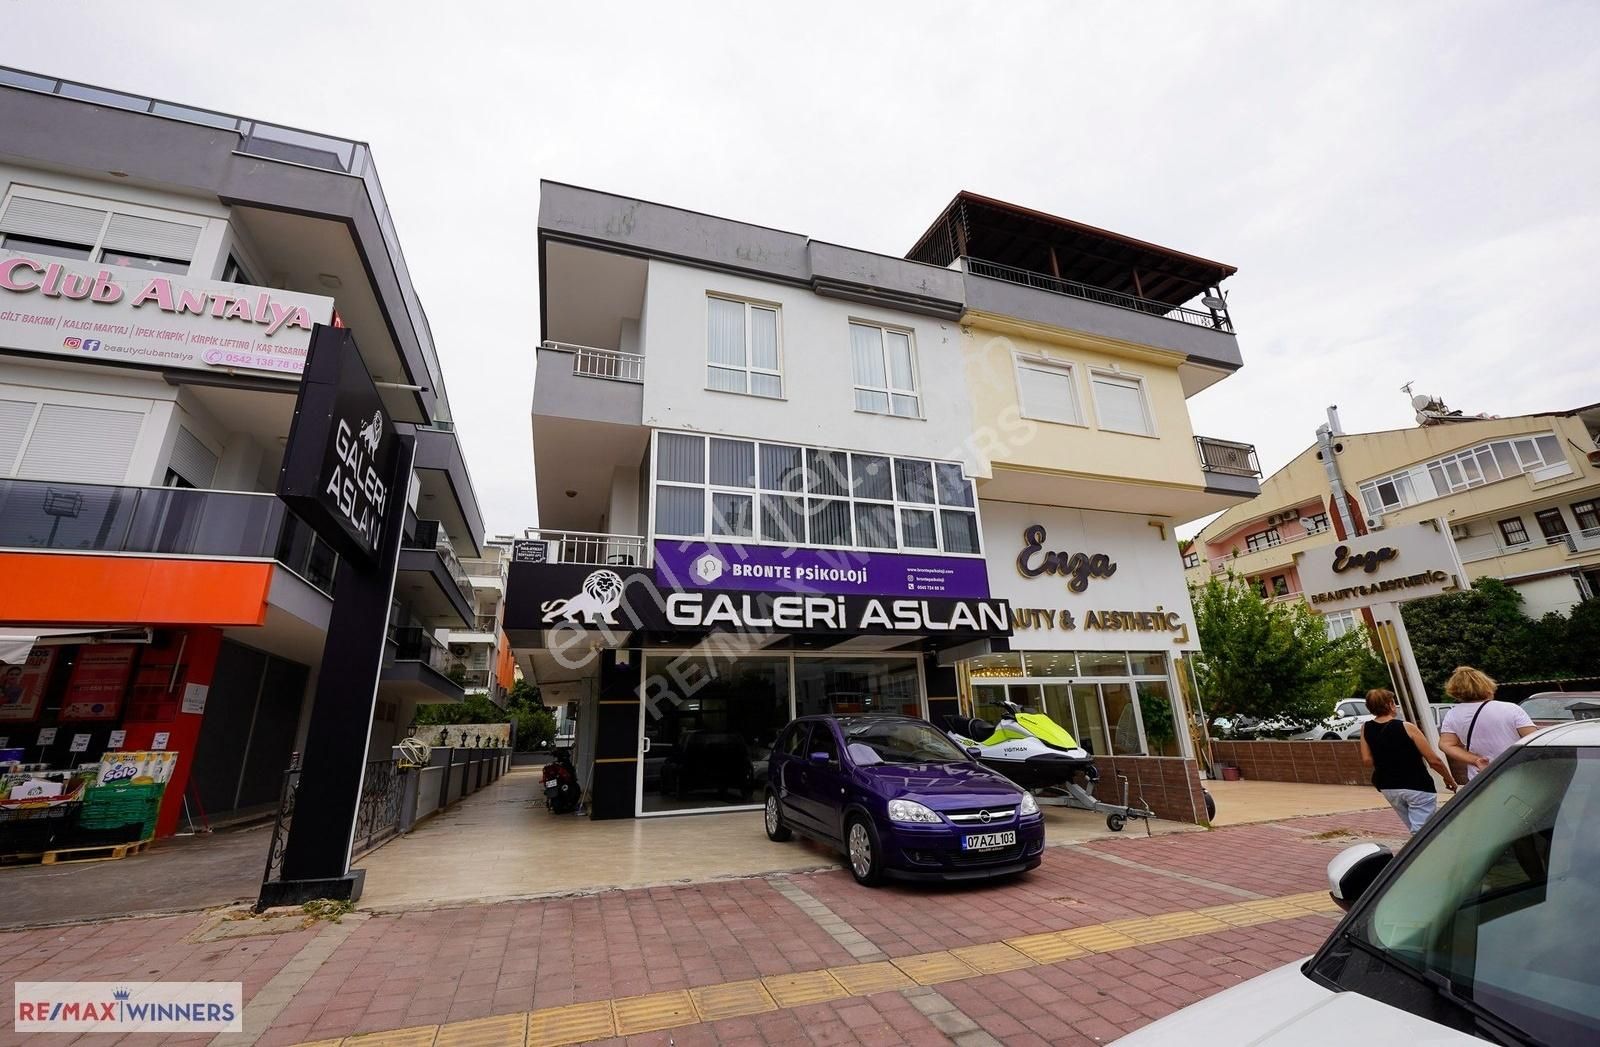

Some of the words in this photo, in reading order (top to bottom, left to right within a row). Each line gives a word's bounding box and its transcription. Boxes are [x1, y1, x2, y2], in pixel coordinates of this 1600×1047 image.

[0, 257, 125, 305] Club
[94, 323, 129, 336] MAKYAJ
[103, 343, 193, 361] beautyclubantalya
[225, 354, 251, 364] 0542
[256, 357, 273, 367] 138
[276, 359, 290, 369] 78
[326, 464, 381, 551] ASLAN
[732, 563, 792, 579] BRONTE
[1311, 587, 1361, 605] BEAUTY
[859, 598, 1009, 631] ASLAN
[1059, 609, 1077, 631] &
